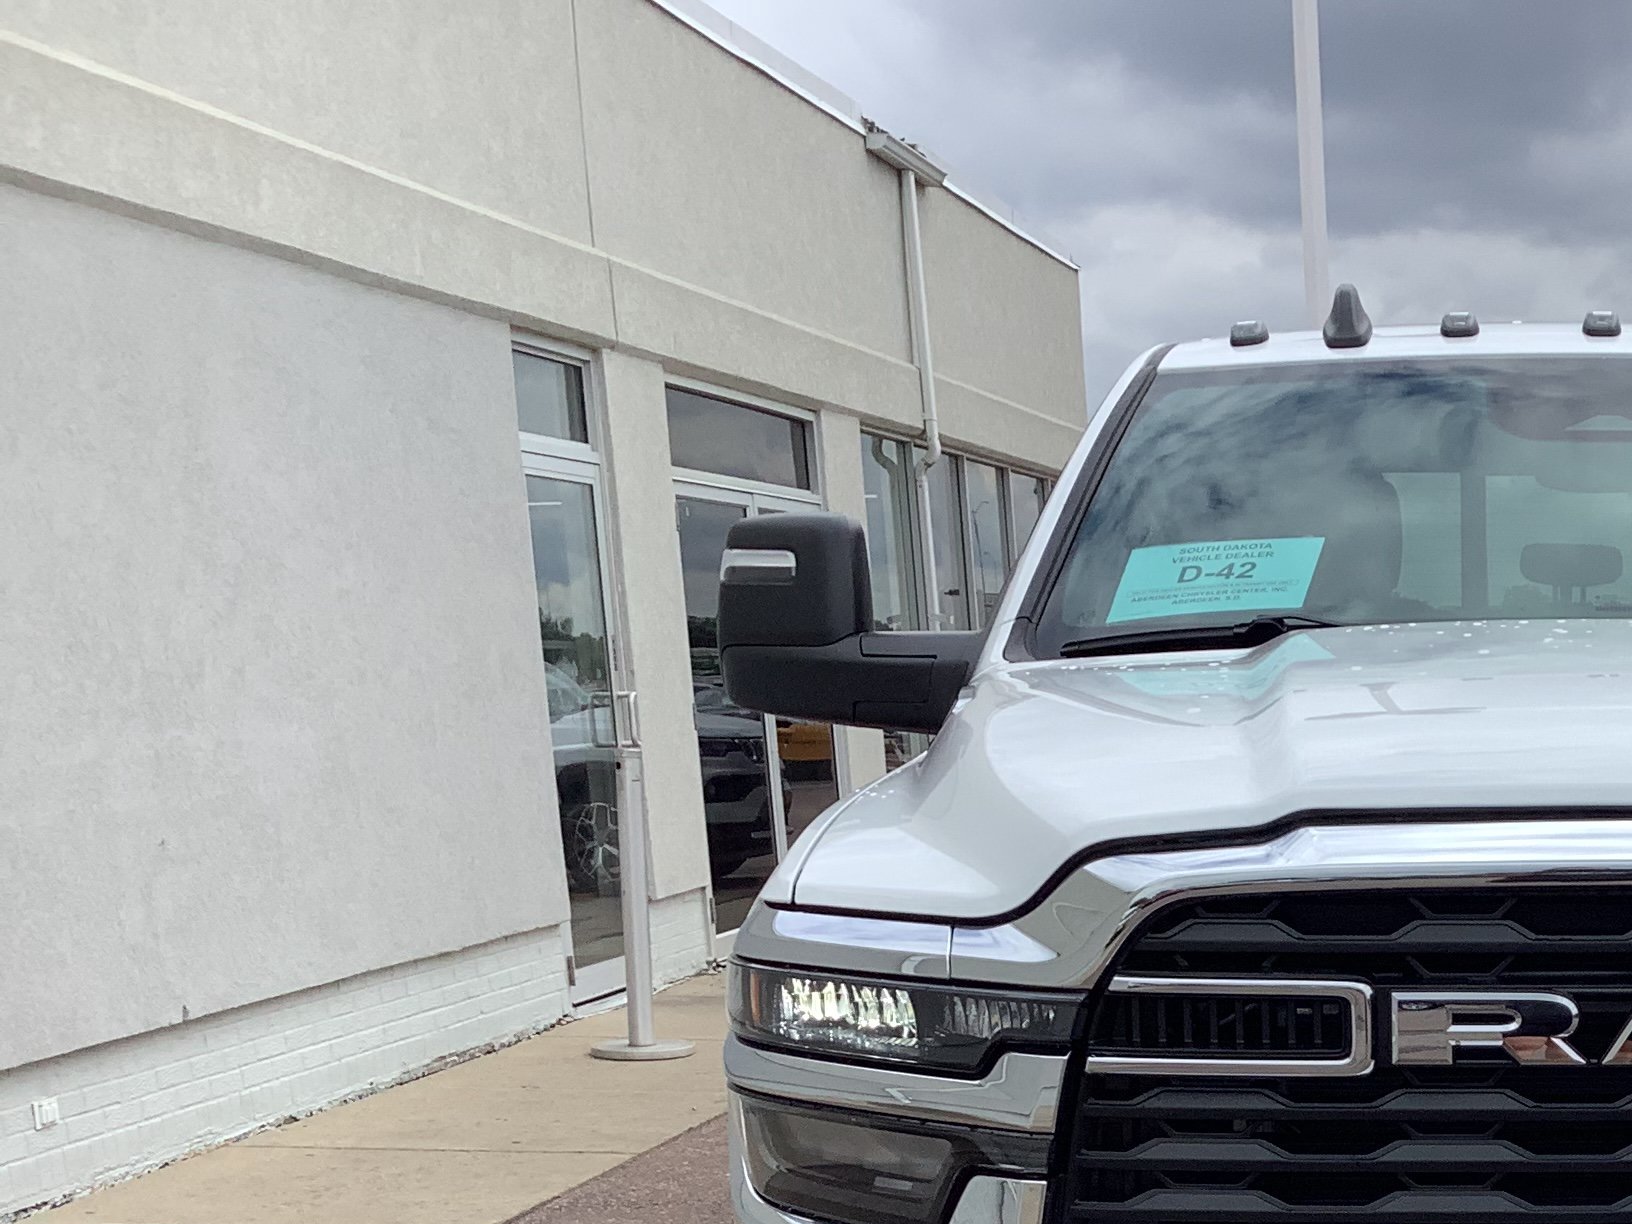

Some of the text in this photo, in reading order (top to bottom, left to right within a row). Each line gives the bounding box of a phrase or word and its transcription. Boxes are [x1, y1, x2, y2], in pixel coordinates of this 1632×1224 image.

[1179, 542, 1273, 554] SOUTH DAKOTA
[1172, 551, 1274, 564] VEHICLE DEALER
[1177, 561, 1257, 583] D-42
